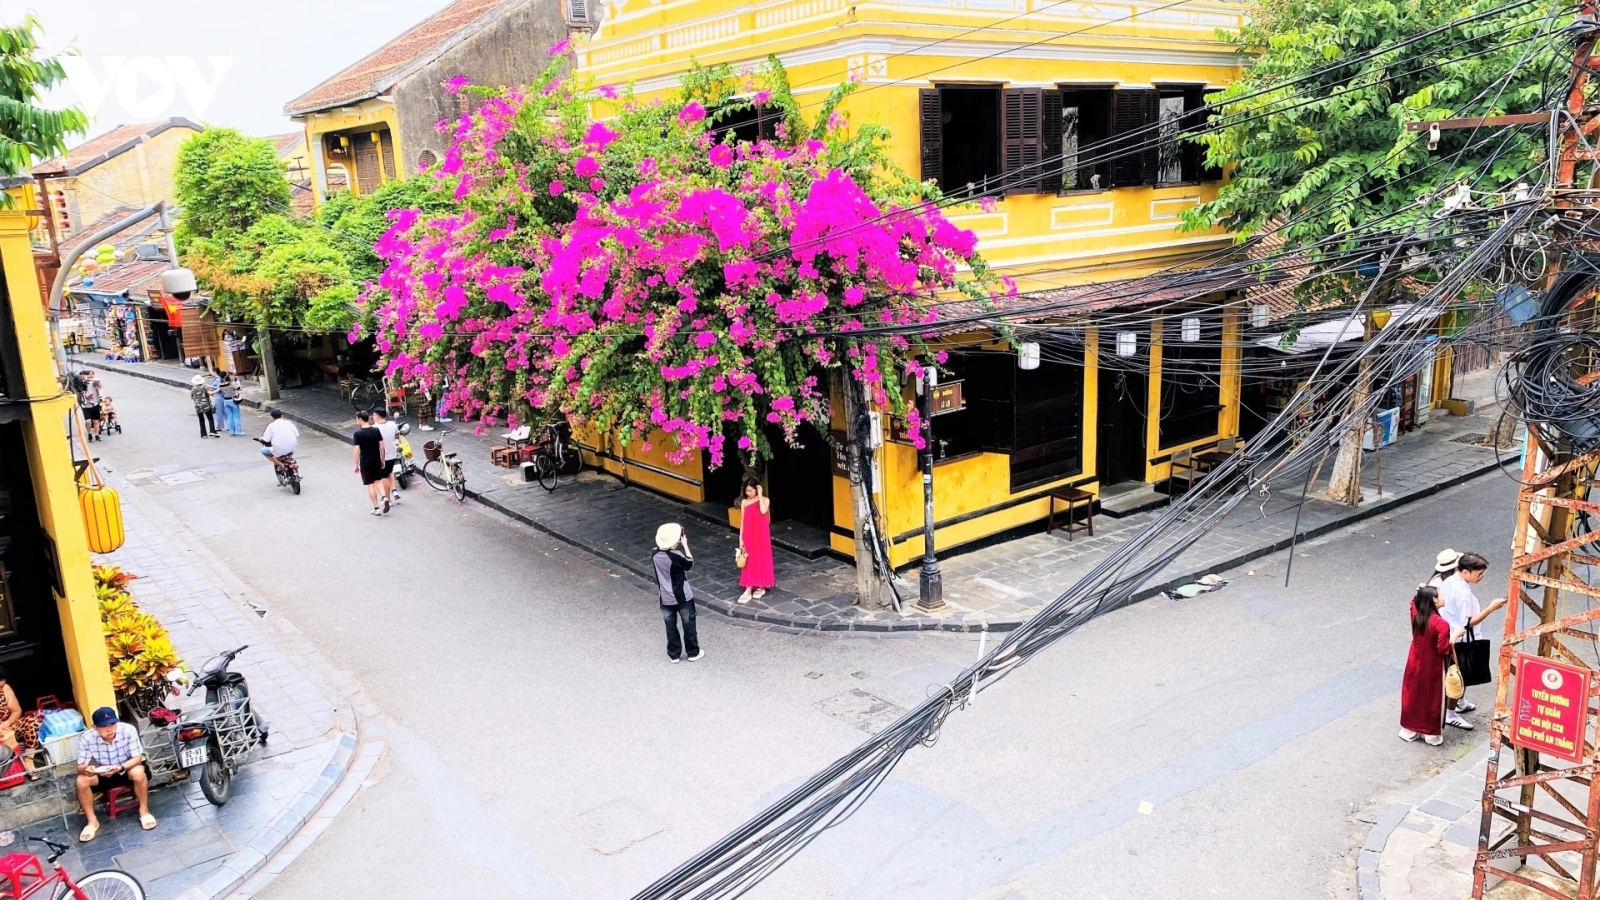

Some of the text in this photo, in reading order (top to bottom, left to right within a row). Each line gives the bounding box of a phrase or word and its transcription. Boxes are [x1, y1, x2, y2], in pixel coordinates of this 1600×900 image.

[1537, 704, 1545, 715] TỰ
[1531, 717, 1541, 726] CHI
[1541, 720, 1551, 731] HỘI
[1519, 727, 1532, 738] KHỐI
[1533, 731, 1545, 741] PHỐ
[1546, 735, 1554, 744] AN
